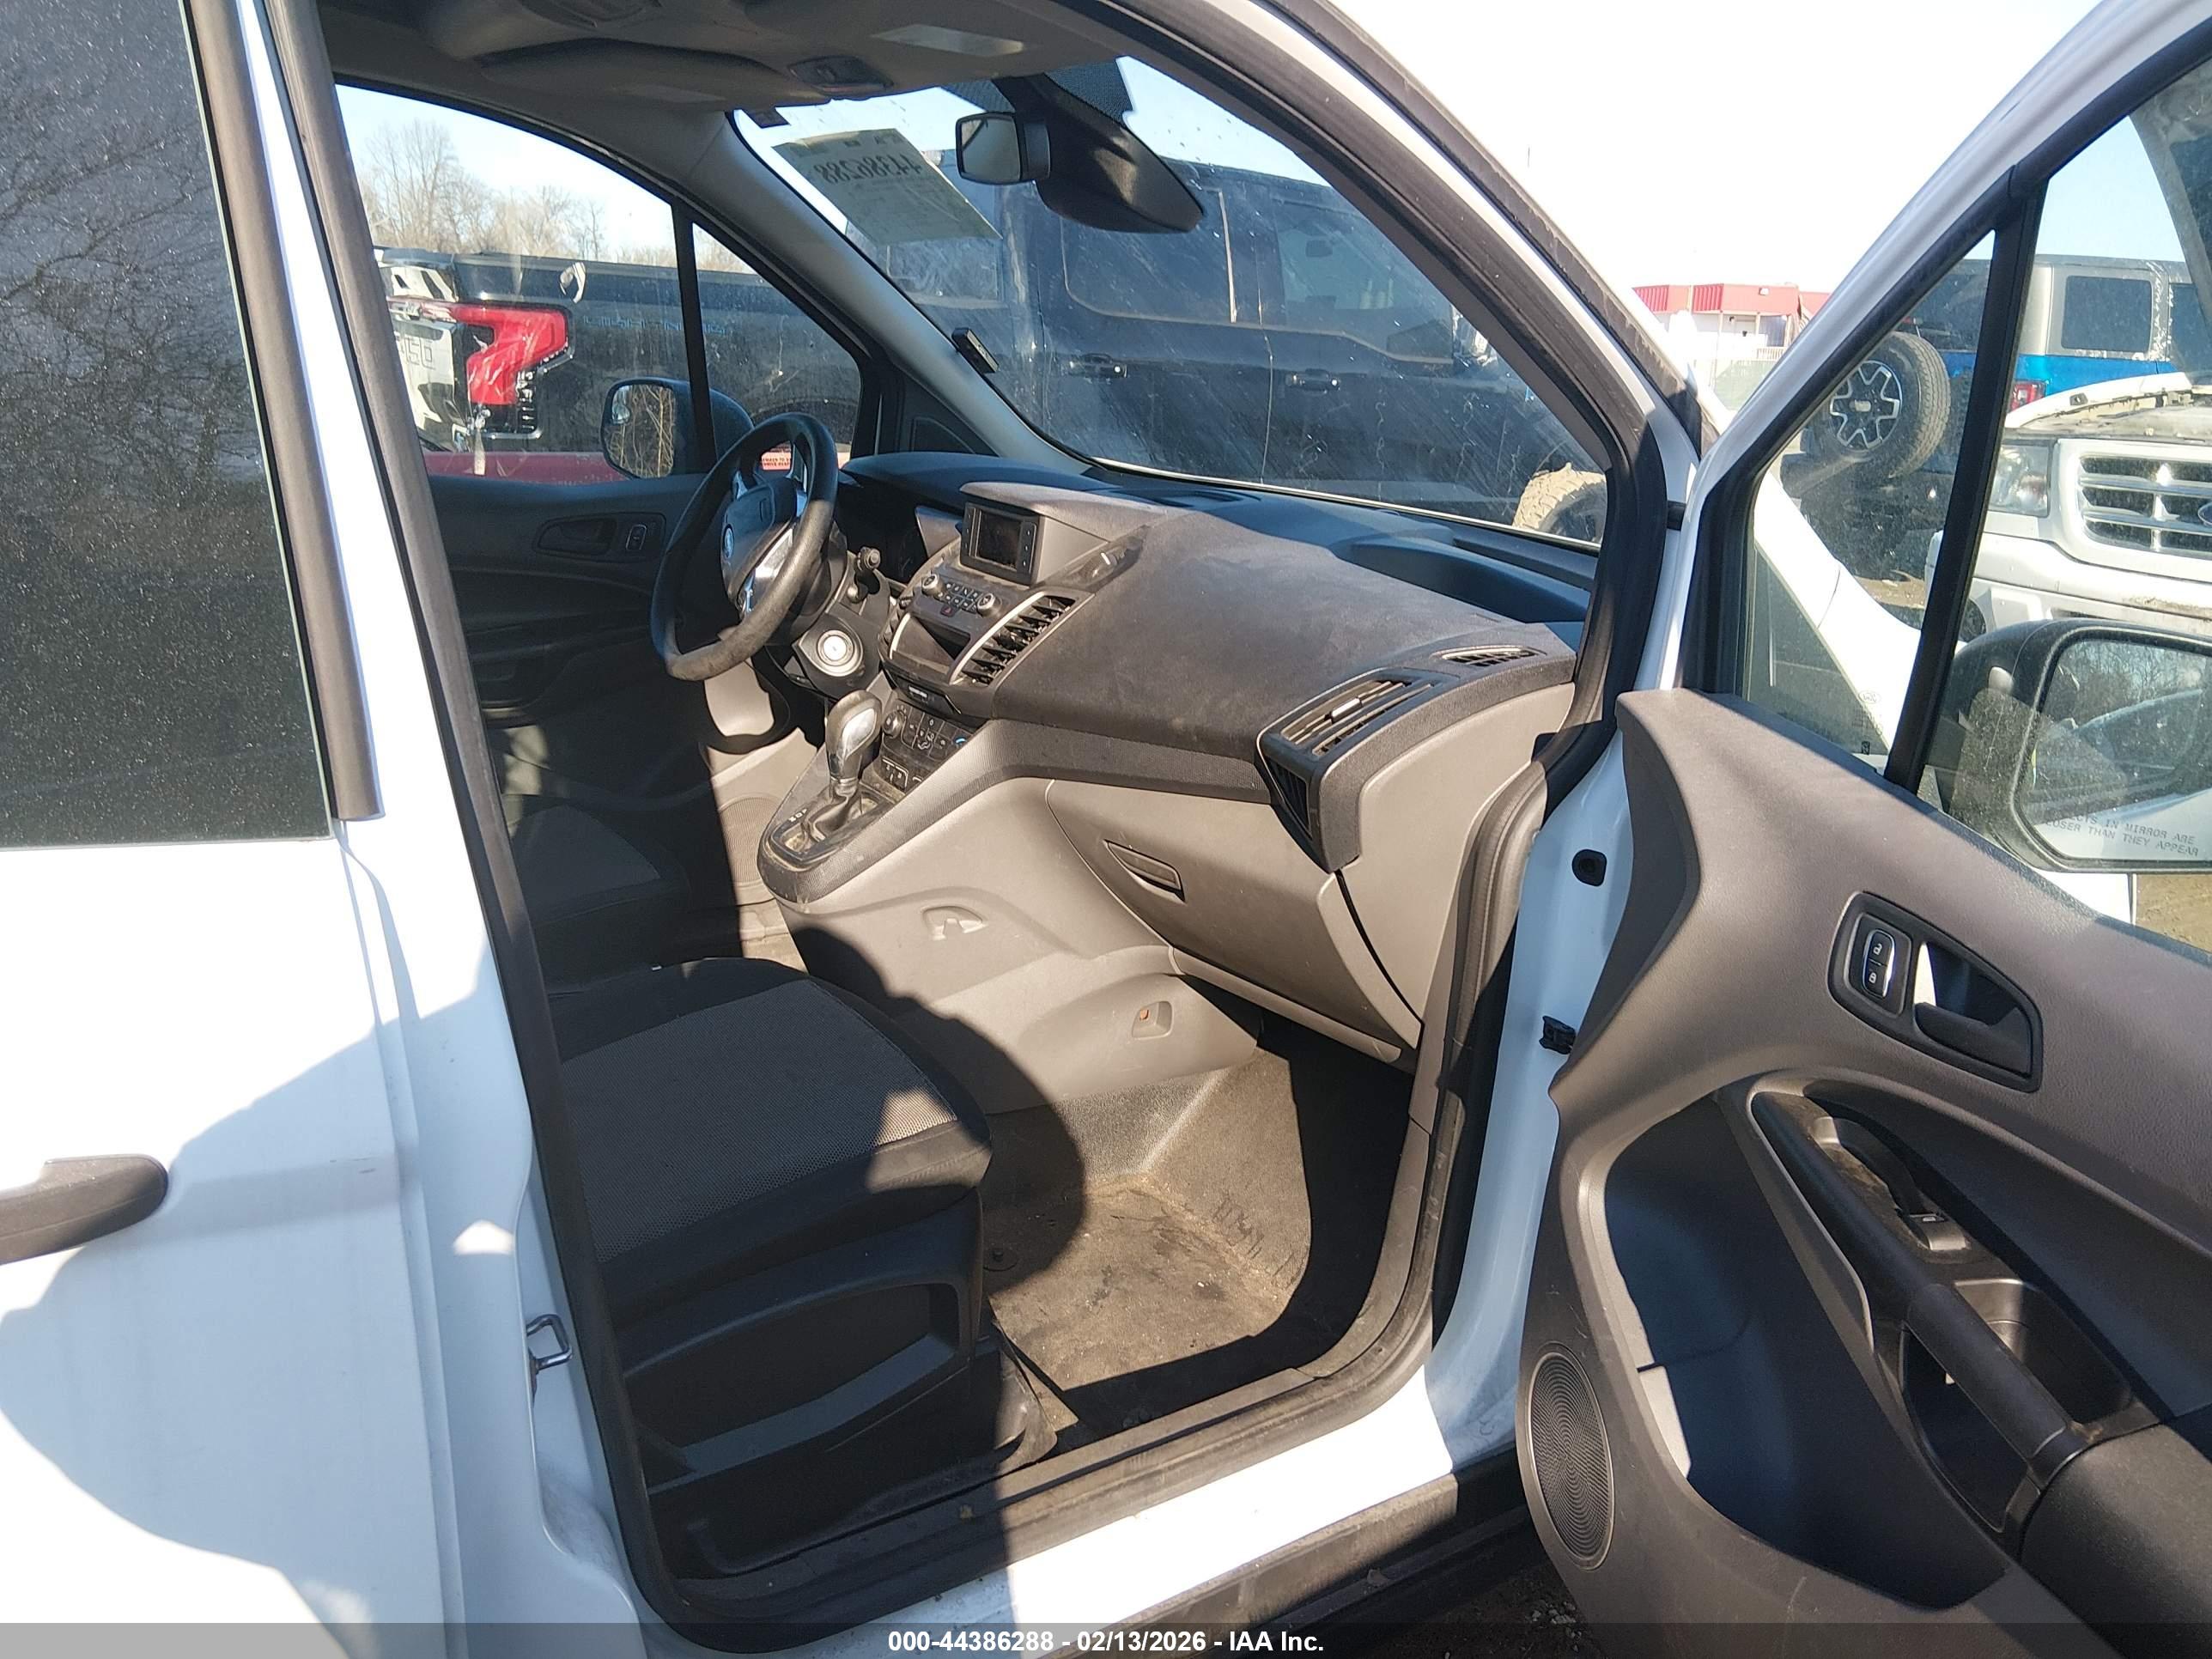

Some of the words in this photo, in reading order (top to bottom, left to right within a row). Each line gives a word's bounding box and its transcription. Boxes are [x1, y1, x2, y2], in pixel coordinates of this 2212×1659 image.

[2046, 820, 2081, 832] LOSER
[2088, 826, 2116, 839] THAN
[2123, 833, 2150, 846] THEY
[2156, 841, 2199, 856] APPEAR
[2106, 818, 2119, 830] IN
[2126, 823, 2167, 839] MIRROR
[2172, 833, 2197, 845] ARE
